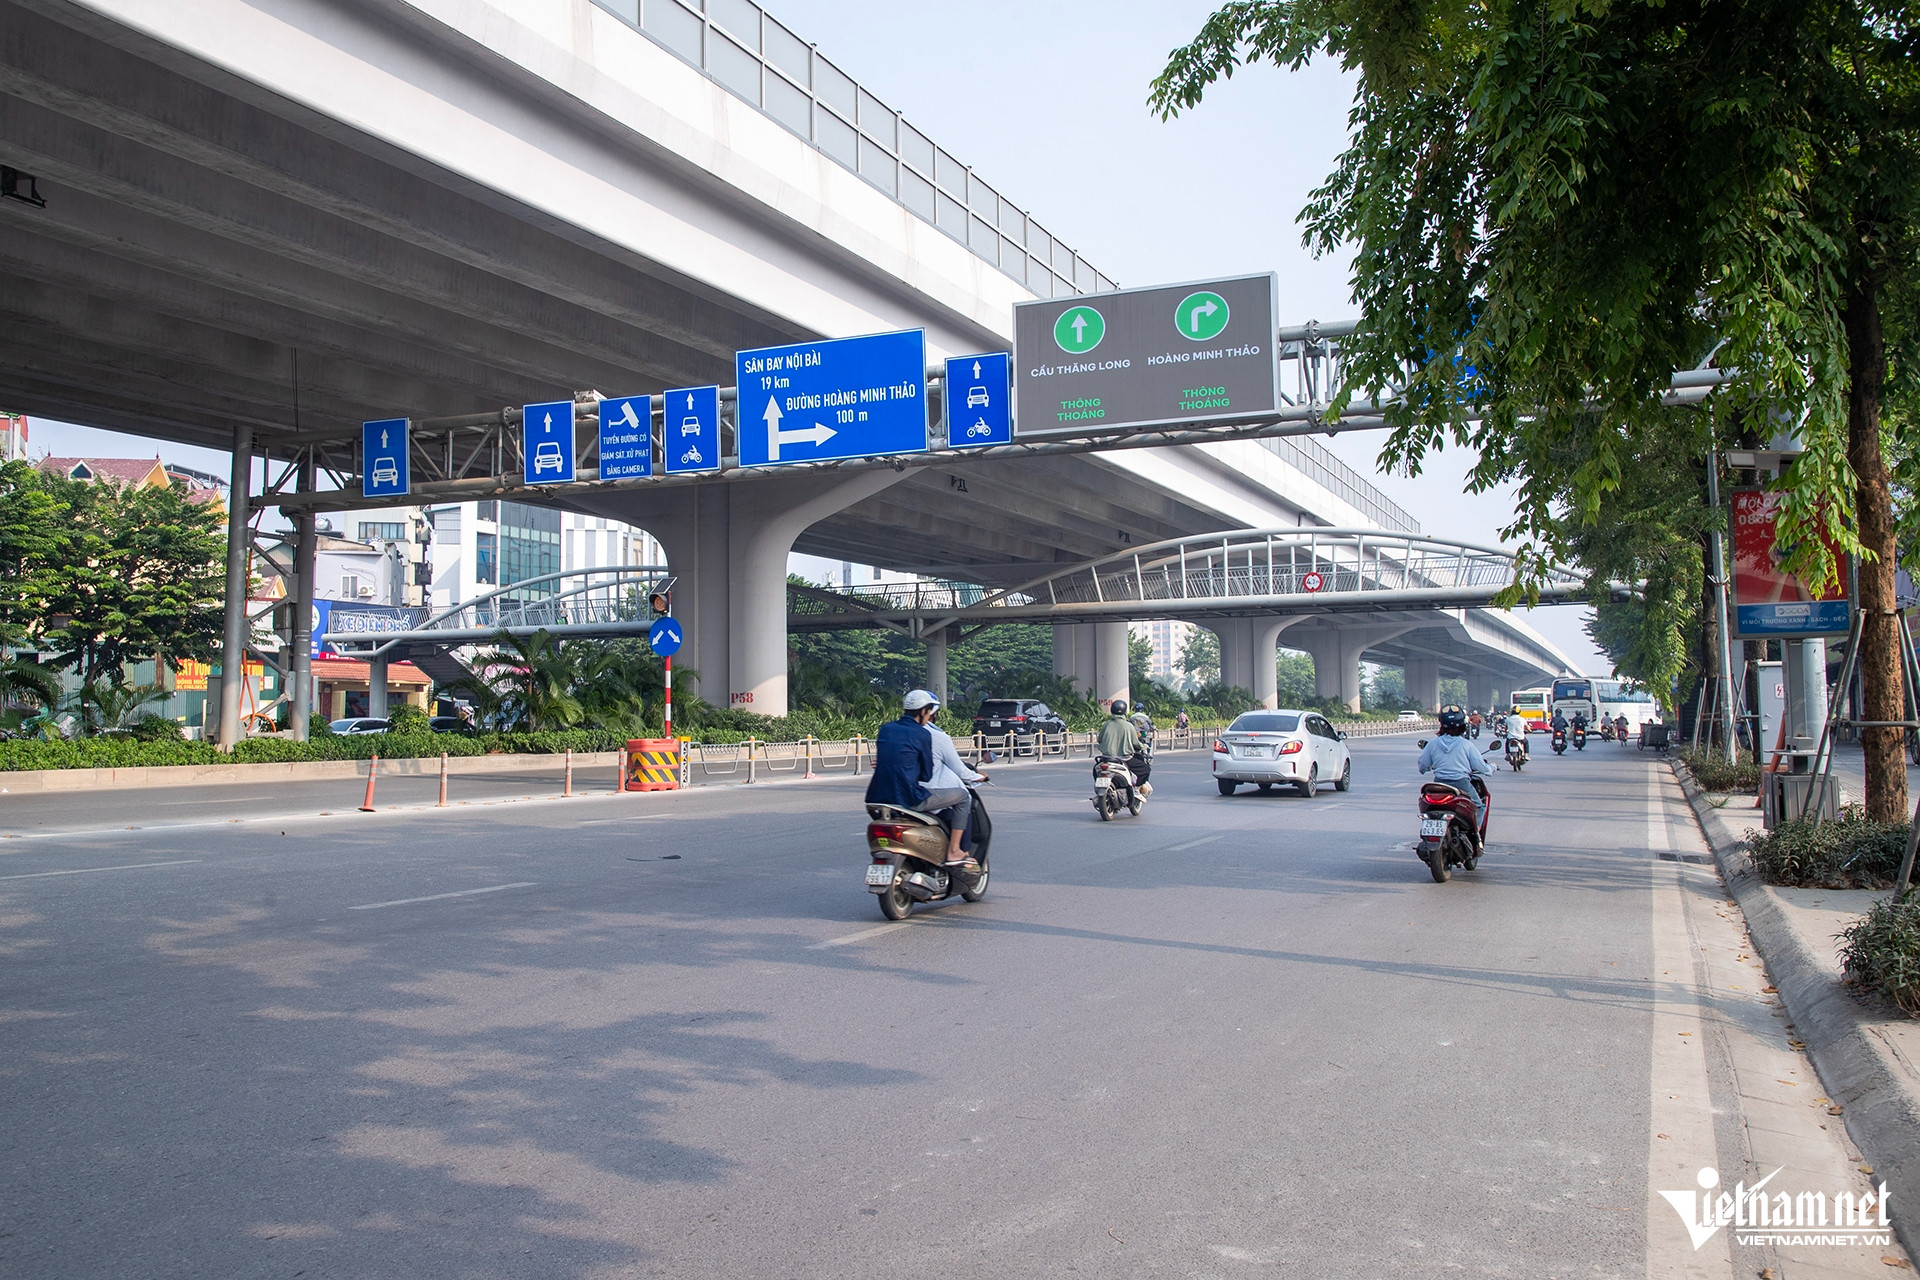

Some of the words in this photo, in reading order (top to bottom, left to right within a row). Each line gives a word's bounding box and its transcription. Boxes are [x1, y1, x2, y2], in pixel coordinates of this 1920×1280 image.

[744, 356, 764, 374] SÂN
[766, 356, 783, 372] BAY
[786, 352, 803, 370] NỘI
[804, 349, 821, 366] BÀI
[1147, 352, 1190, 366] HOÀNG
[1192, 349, 1223, 362] MINH
[1225, 343, 1260, 358] THẢO
[1030, 362, 1054, 378] CẦU
[1057, 358, 1097, 375] THĂNG
[1099, 358, 1131, 371] LONG
[760, 376, 772, 390] 19
[774, 375, 790, 389] km
[786, 391, 821, 411] ĐƯỜNG
[823, 388, 857, 407] HOÀNG
[859, 386, 887, 403] MINH
[889, 381, 916, 399] THẢO
[1183, 385, 1226, 399] THÔNG
[1060, 396, 1101, 410] THÔNG
[1179, 395, 1231, 411] THOÁNG
[836, 409, 854, 424] 100
[858, 410, 868, 422] m
[1057, 406, 1106, 422] THOÁNG
[639, 431, 647, 442] CÓ
[621, 464, 645, 474] CAMERA
[1784, 606, 1809, 614] GODA
[731, 692, 754, 704] P58
